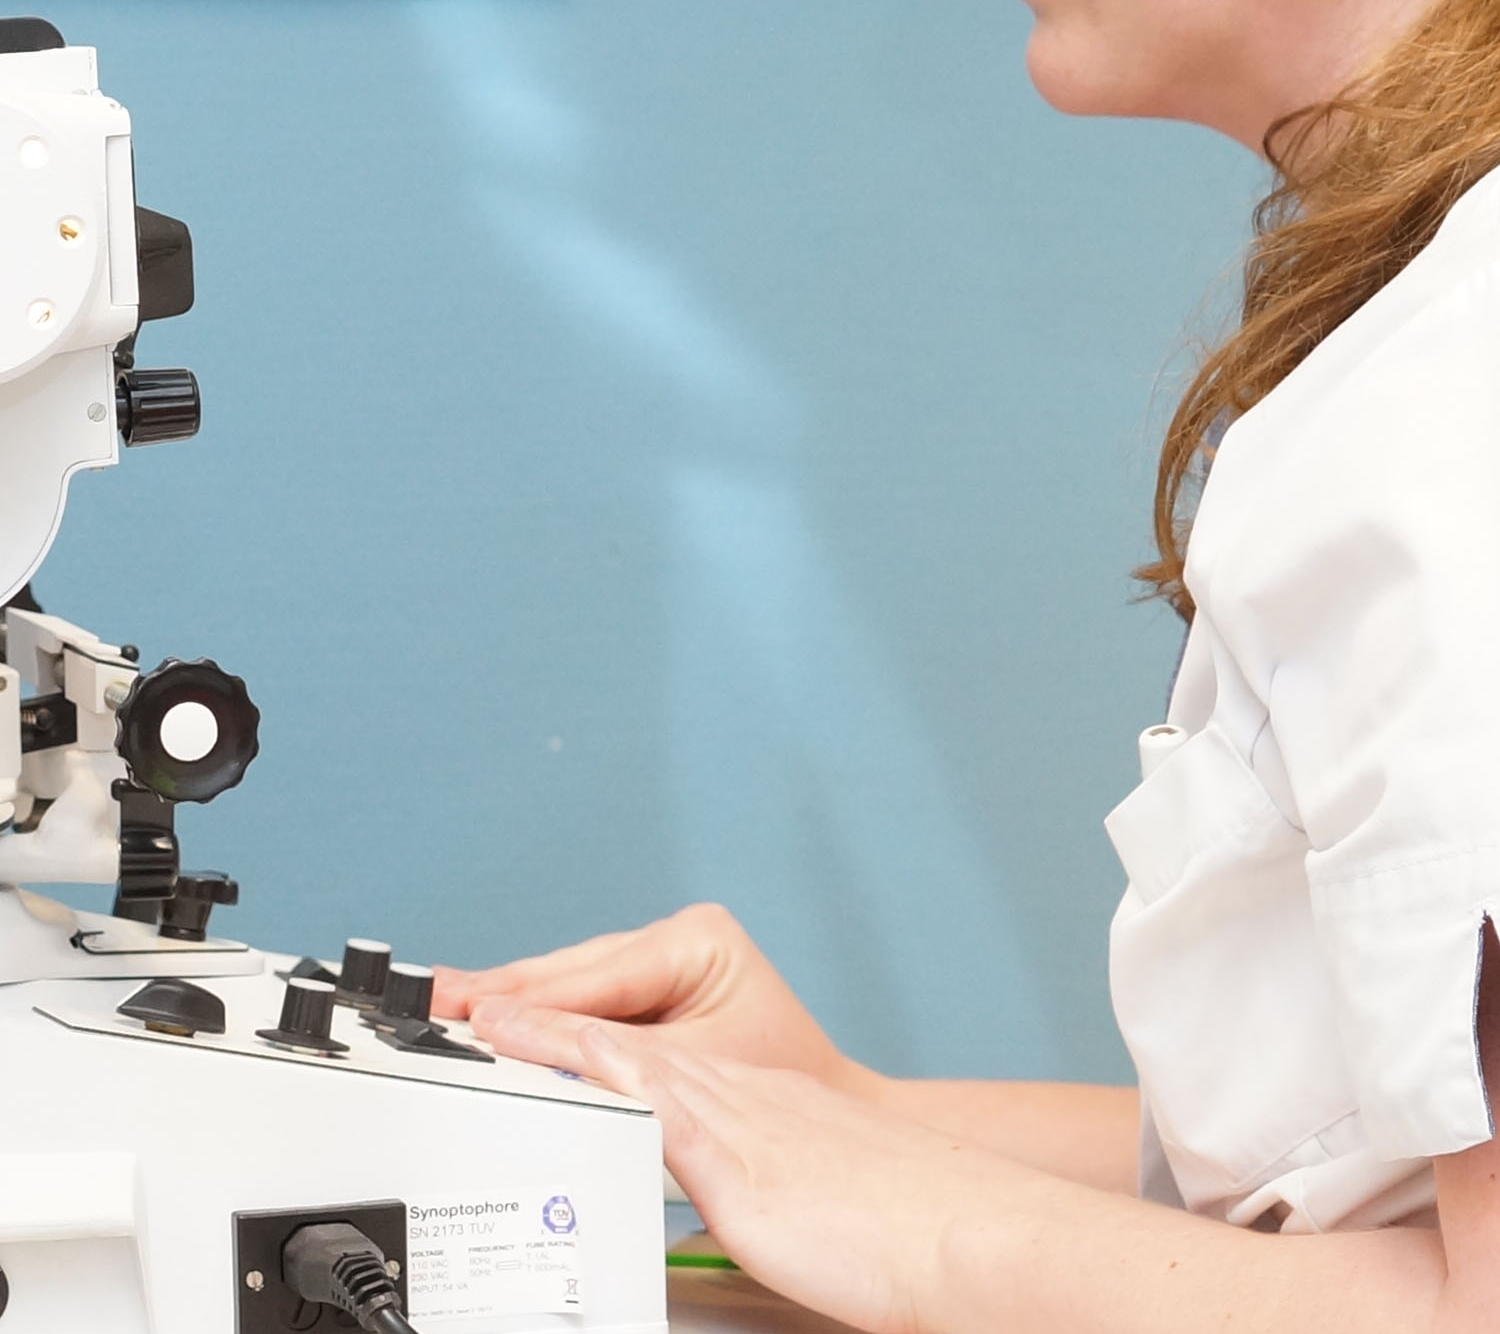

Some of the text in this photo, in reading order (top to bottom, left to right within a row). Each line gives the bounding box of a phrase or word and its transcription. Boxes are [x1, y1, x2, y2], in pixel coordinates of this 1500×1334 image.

[409, 1201, 520, 1222] Synoptophore
[409, 1221, 496, 1240] SN 2173 TUV
[410, 1249, 445, 1259] VOLTAGE
[467, 1244, 516, 1254] FREQUENCY
